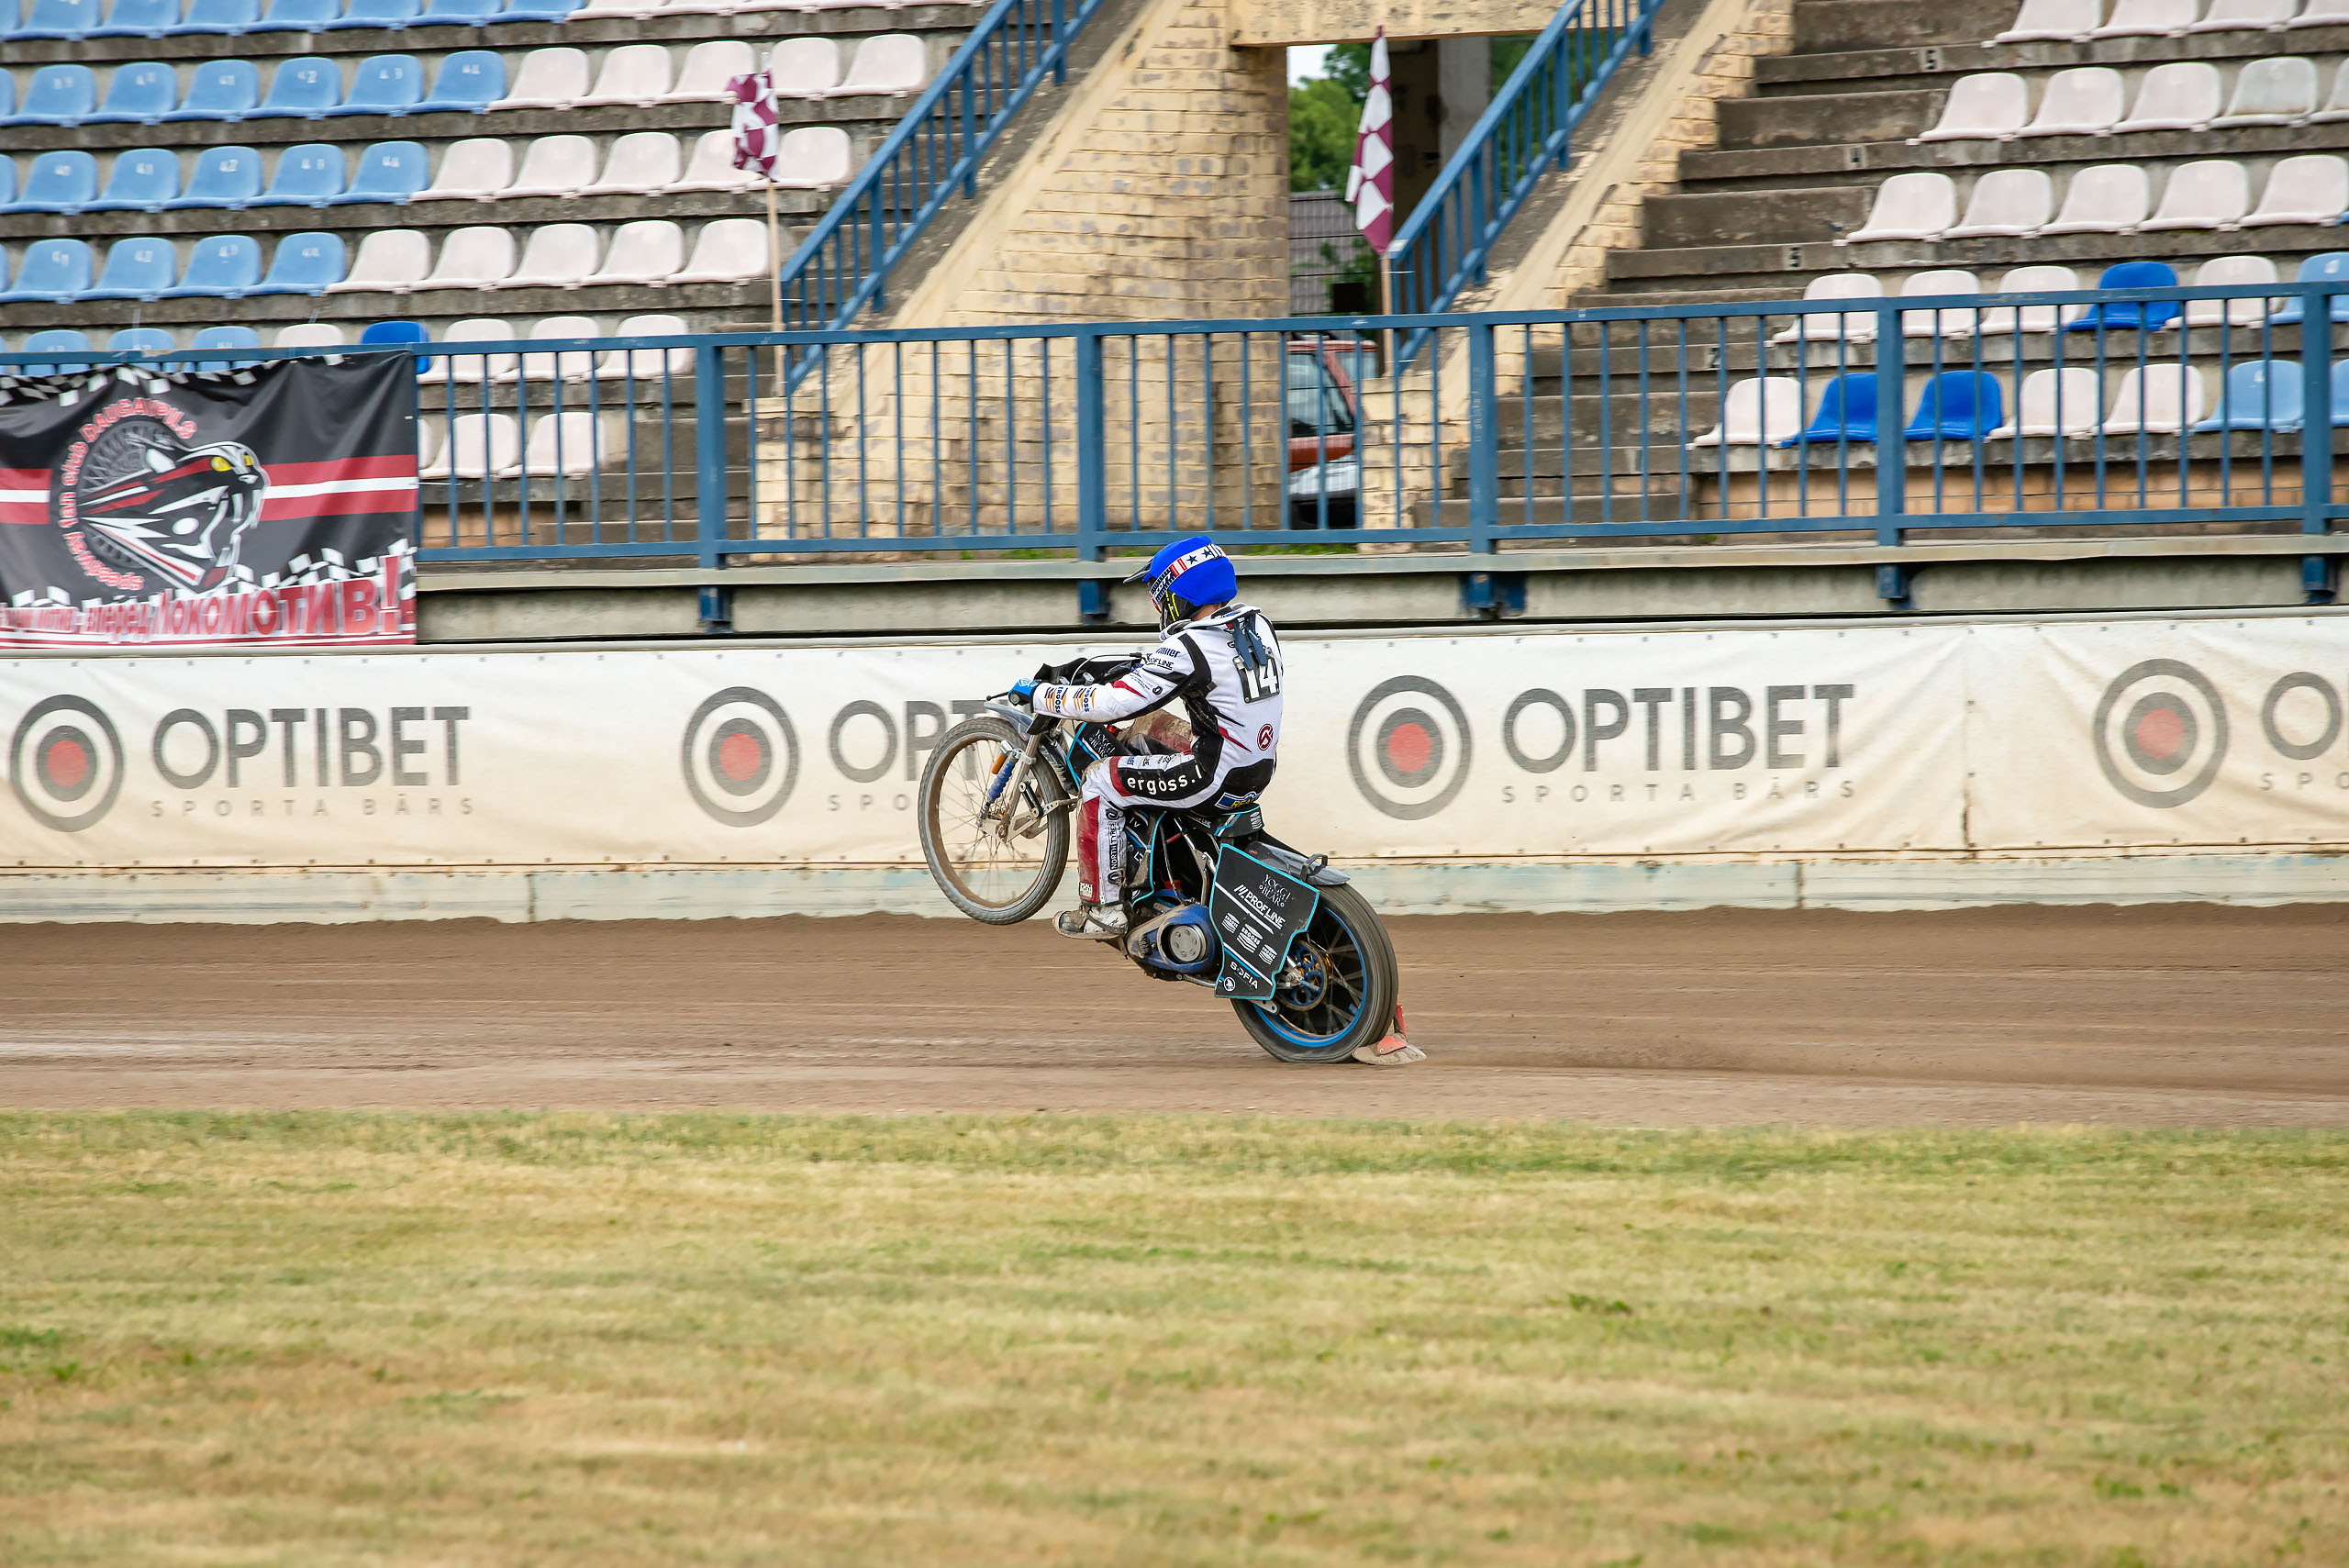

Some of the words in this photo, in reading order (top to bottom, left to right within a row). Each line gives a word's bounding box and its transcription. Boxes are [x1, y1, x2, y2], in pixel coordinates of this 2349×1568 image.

[79, 397, 197, 439] DAUGAVPILS
[1245, 658, 1278, 699] 14
[151, 706, 471, 789] OPTIBET
[1503, 684, 1854, 773] OPTIBET
[150, 799, 328, 817] SPORTA
[362, 794, 473, 816] BĀRS
[1501, 784, 1696, 804] SPORTA
[1732, 777, 1855, 801] BĀRS
